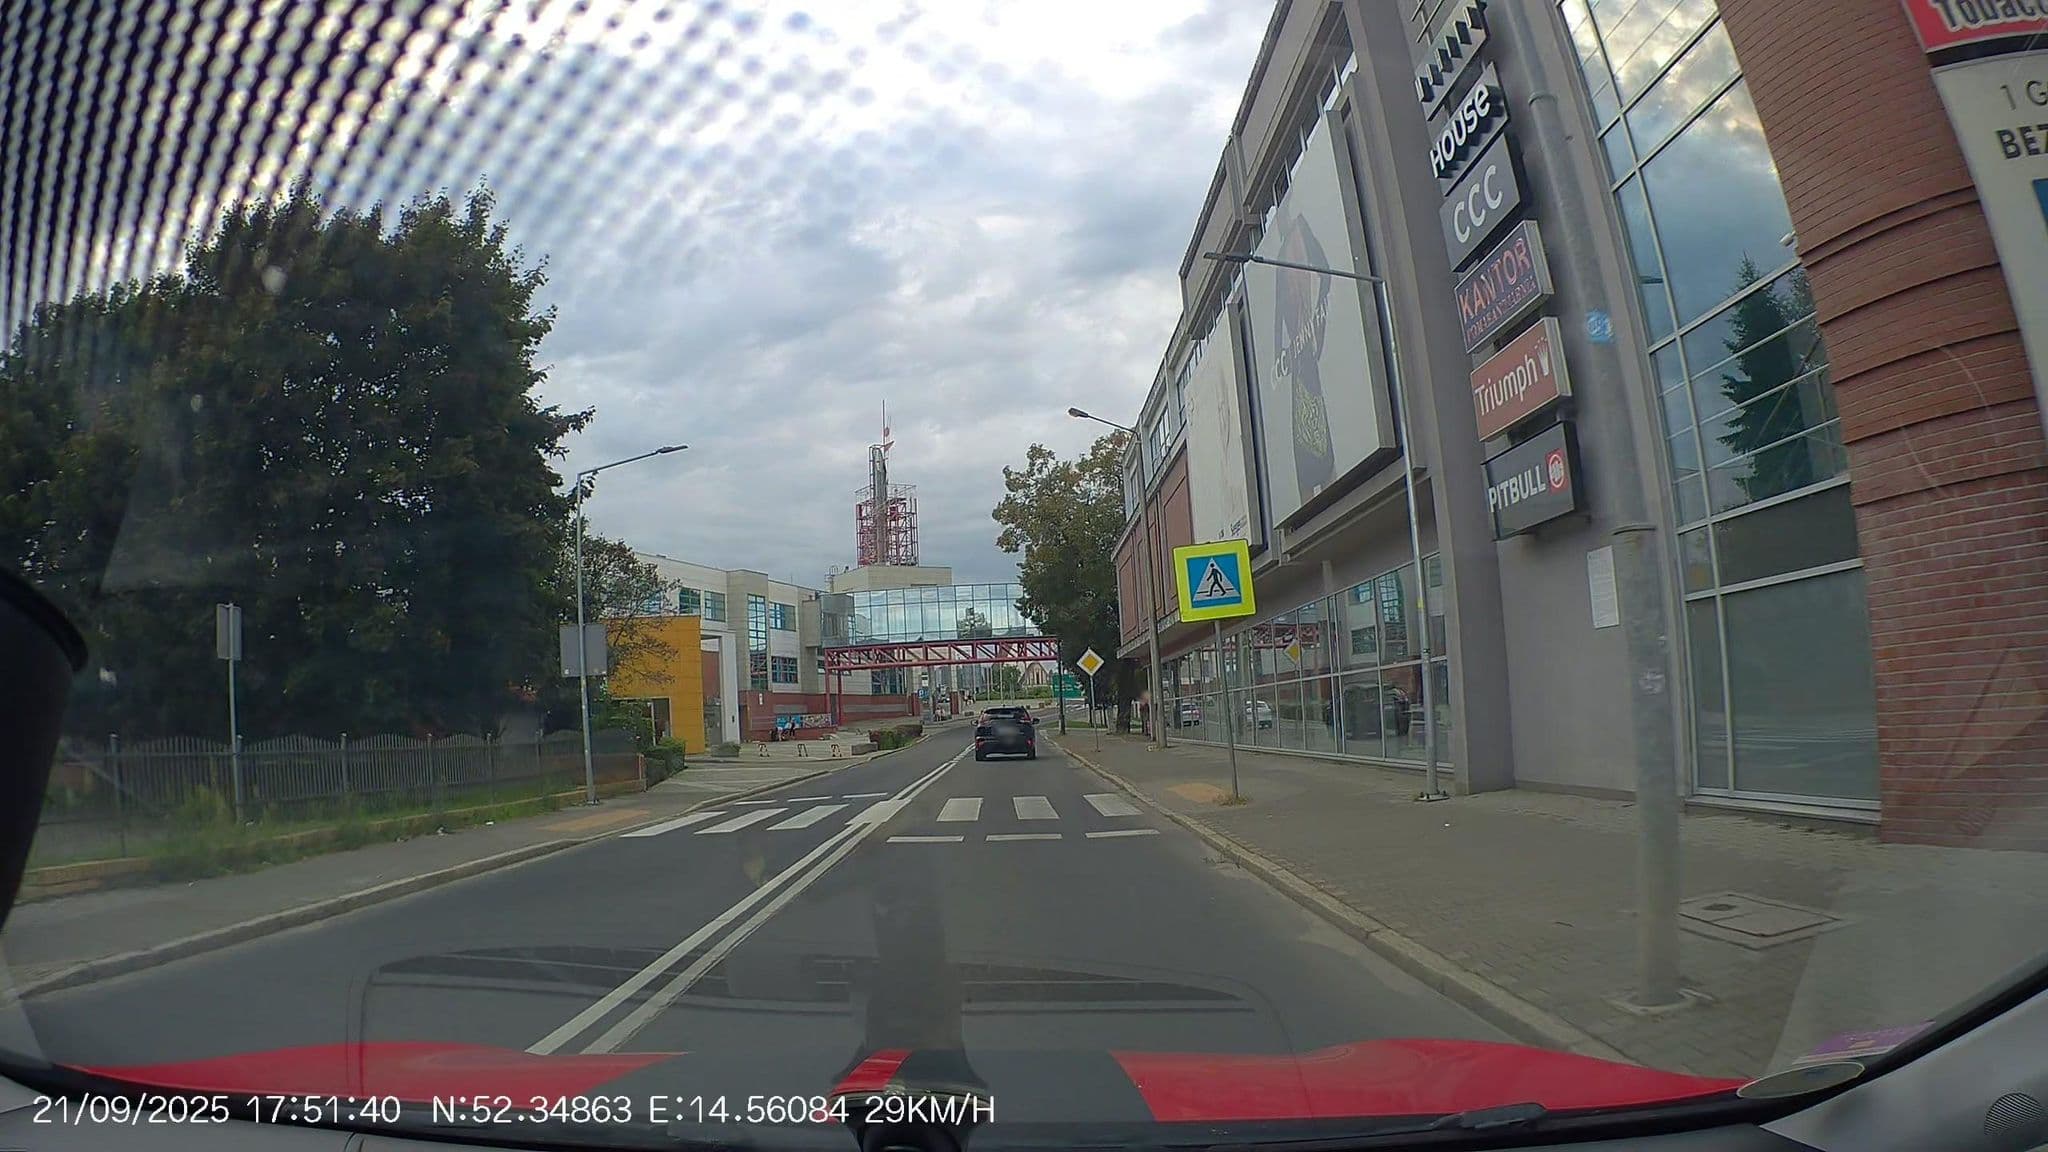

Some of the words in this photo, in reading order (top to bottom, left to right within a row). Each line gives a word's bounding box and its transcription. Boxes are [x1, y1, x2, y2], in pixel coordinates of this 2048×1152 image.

[2000, 84, 2017, 111] 1
[2026, 79, 2048, 107] G
[1453, 164, 1504, 244] CCC
[1460, 237, 1531, 325] KANTOR
[1475, 354, 1539, 417] Triumph
[1487, 464, 1547, 513] PITBULL
